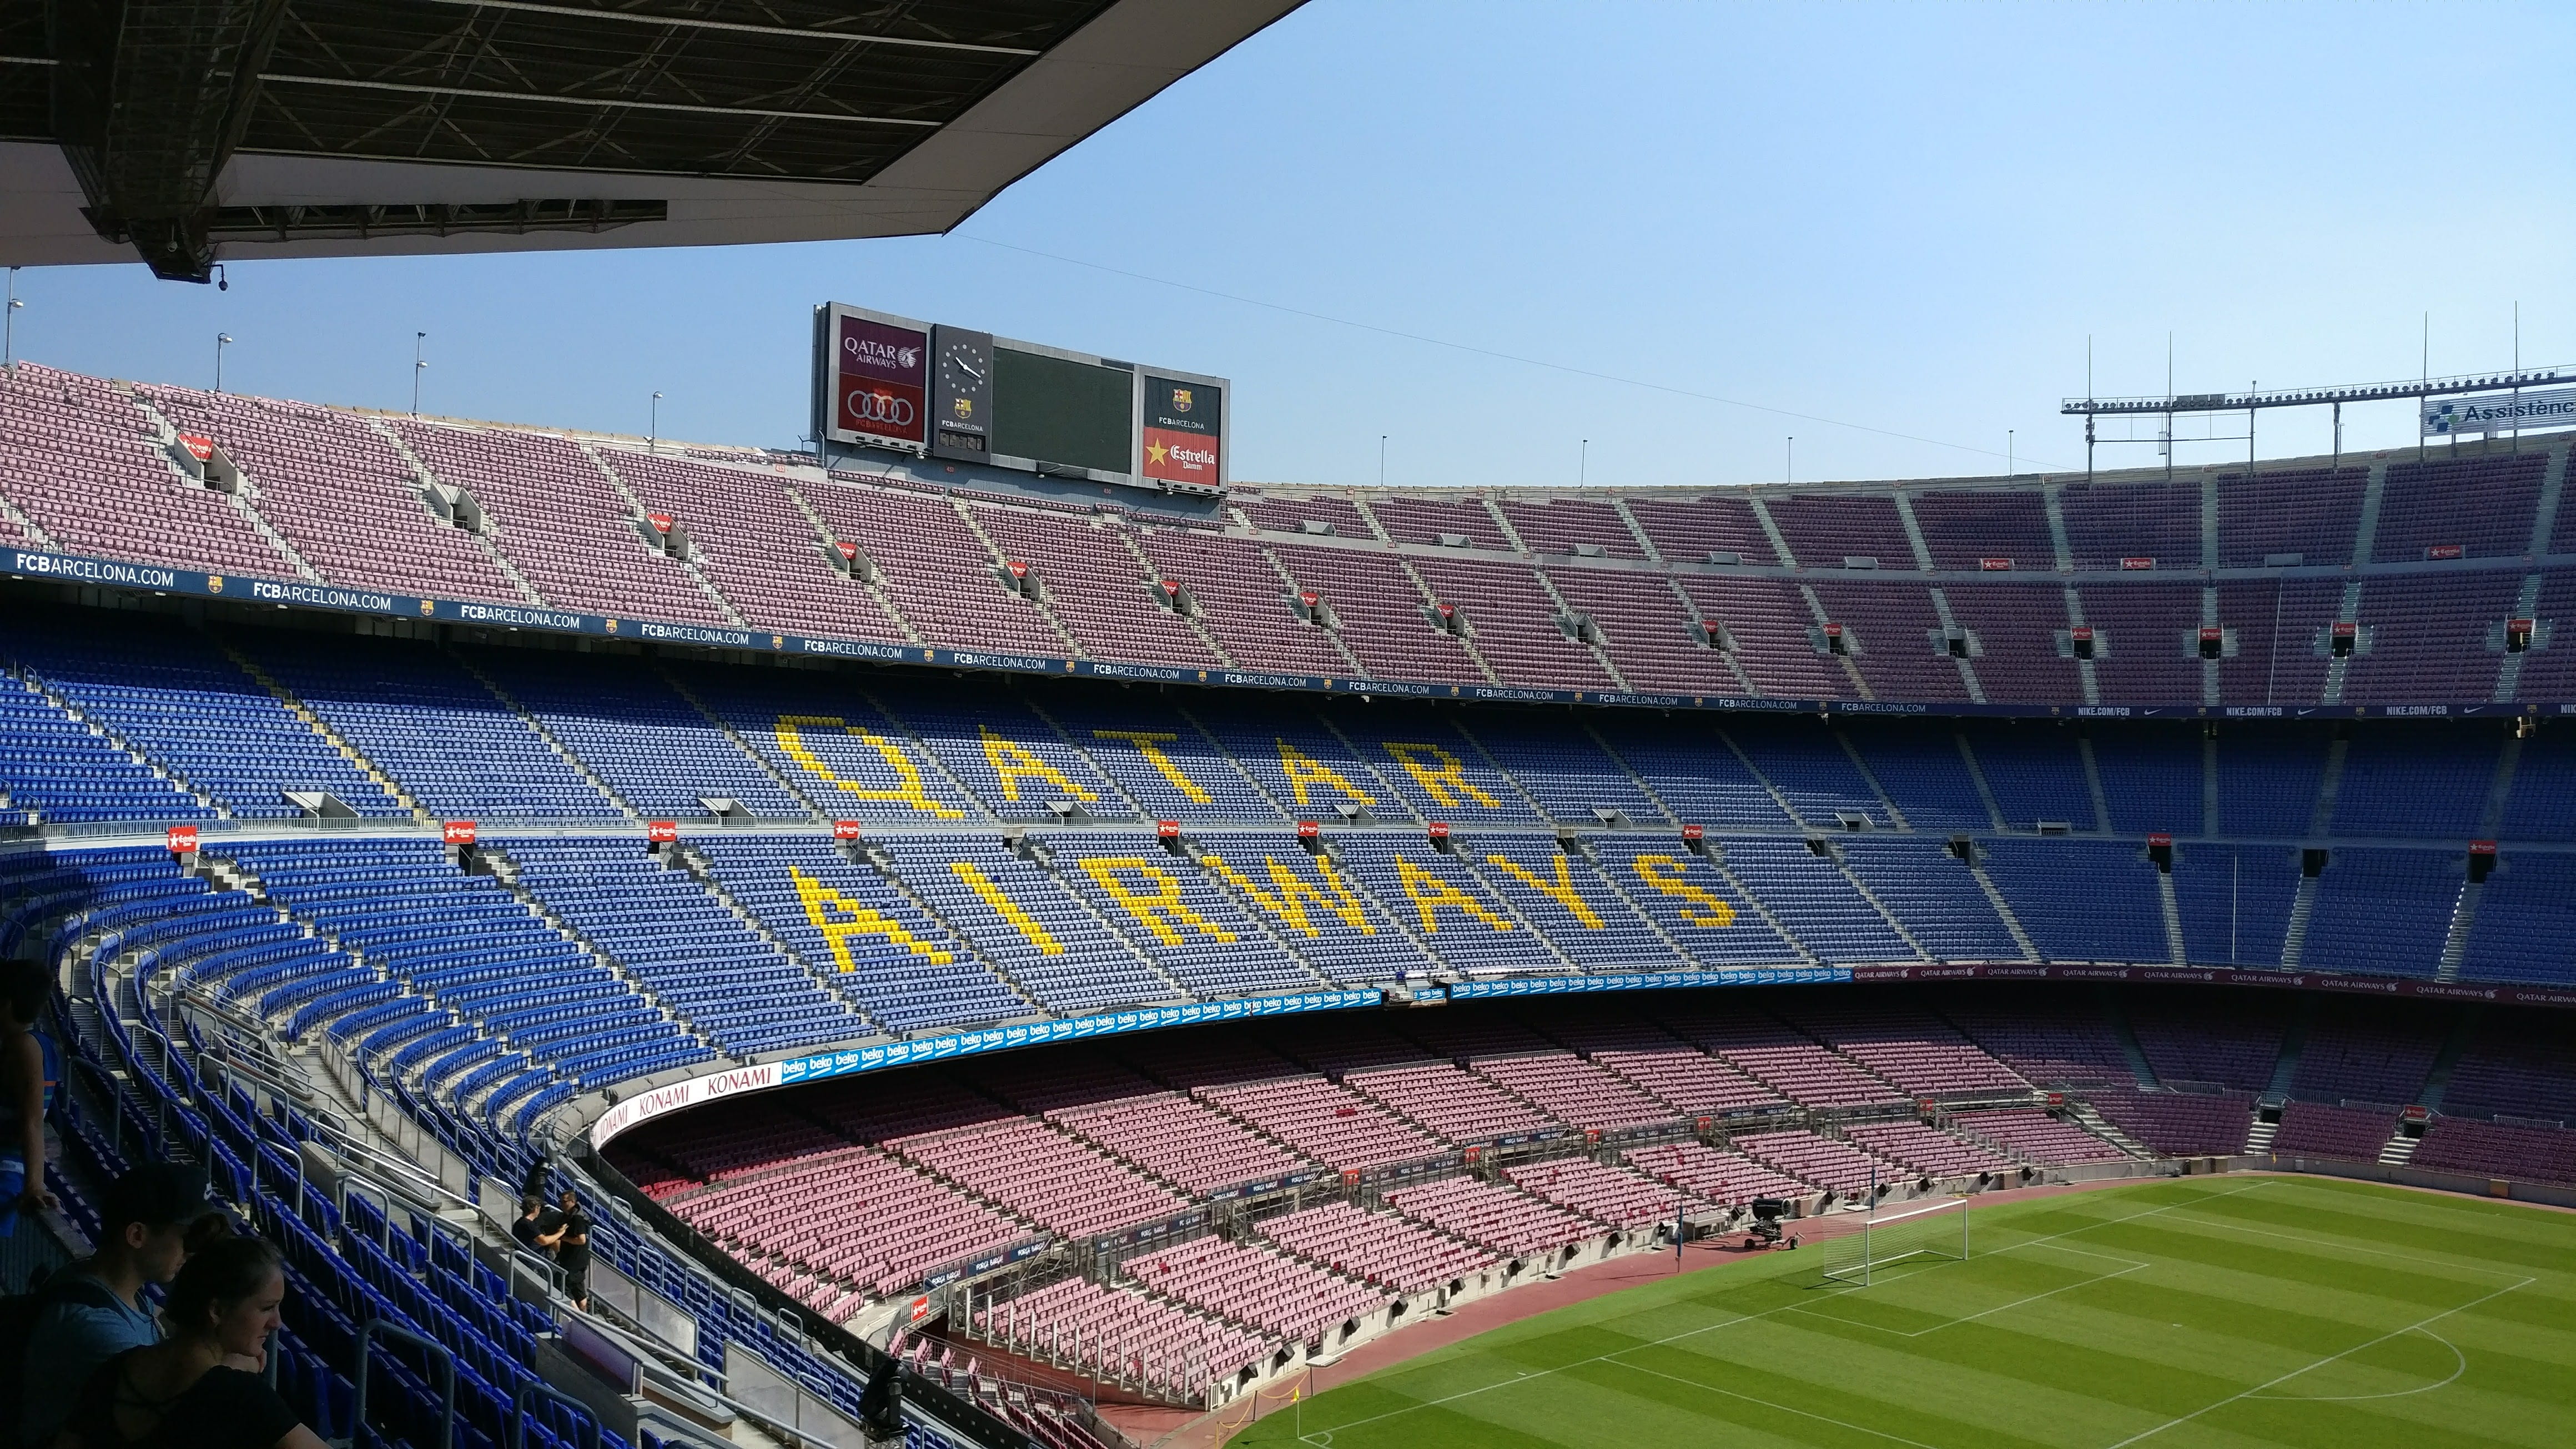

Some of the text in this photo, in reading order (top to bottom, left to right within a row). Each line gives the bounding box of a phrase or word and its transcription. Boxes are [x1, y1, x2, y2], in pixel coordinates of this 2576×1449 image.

[844, 337, 896, 360] QATAR
[857, 354, 896, 369] AIRWAYS
[942, 420, 983, 432] FCBARCELONA
[1159, 417, 1205, 430] FCBARCELONA
[1170, 444, 1215, 465] Estrella
[1183, 461, 1203, 471] Damm
[17, 554, 173, 587] FCBARCELONA.COM
[254, 582, 391, 611] FCBARCELONA.COM
[461, 605, 579, 629] FCBARCELONA.COM
[642, 624, 749, 646] FCBARCELONA.COM
[804, 640, 902, 659] FCBARCELONA.COM
[954, 653, 1045, 670] FCBARCELONA.COM
[1094, 664, 1179, 680] FCBARCELONA.COM
[1225, 674, 1306, 687] FCBARCELONA.COM
[1349, 681, 1429, 694] FCBARCELONA.COM
[1476, 688, 1553, 700] FCBARCELONA.COM
[1599, 693, 1678, 706] FCBARCELONA.COM
[1719, 699, 1797, 710] FCBARCELONA.COM
[1842, 703, 1925, 713] FCBARCELONA.COM
[2387, 704, 2447, 716] NIKE.COM/FCB
[2078, 707, 2130, 716] NIKE.COM/FCB
[2226, 706, 2282, 717] NIKE.COM/FCB
[773, 715, 1501, 818] QATAR
[788, 854, 1737, 973] AIRWAYS
[1855, 970, 1900, 979] QATAR AIRWAYS
[1453, 984, 1470, 993] beko
[1511, 981, 1528, 989] beko
[1531, 980, 1547, 988] beko
[1549, 979, 1566, 987] beko
[2349, 981, 2385, 989] AIRWAYS
[1344, 992, 1360, 1001] beko
[1363, 990, 1379, 999] beko
[2417, 985, 2483, 997] QATAR AIRWAYS
[1285, 997, 1301, 1006] beko
[1305, 995, 1322, 1004] beko
[1324, 994, 1341, 1003] beko
[2517, 993, 2547, 1001] QATAR
[1224, 1002, 1241, 1012] beko
[1264, 998, 1281, 1008] beko
[1161, 1009, 1179, 1019] beko
[1182, 1007, 1200, 1017] beko
[1203, 1004, 1220, 1014] beko
[1096, 1016, 1115, 1027] beko
[1118, 1014, 1137, 1024] beko
[1140, 1012, 1158, 1022] beko
[1030, 1024, 1050, 1036] beko
[1053, 1022, 1073, 1033] beko
[1075, 1019, 1095, 1030] beko
[984, 1031, 1004, 1043] beko
[1007, 1028, 1027, 1039] beko
[935, 1038, 957, 1049] beko
[961, 1034, 982, 1045] beko
[887, 1045, 909, 1057] beko
[912, 1042, 933, 1053] beko
[836, 1053, 858, 1065] beko
[862, 1049, 884, 1061] beko
[783, 1061, 806, 1074] beko
[810, 1057, 832, 1070] beko
[708, 1067, 771, 1095] KONAMI
[639, 1085, 689, 1117] KONAMI
